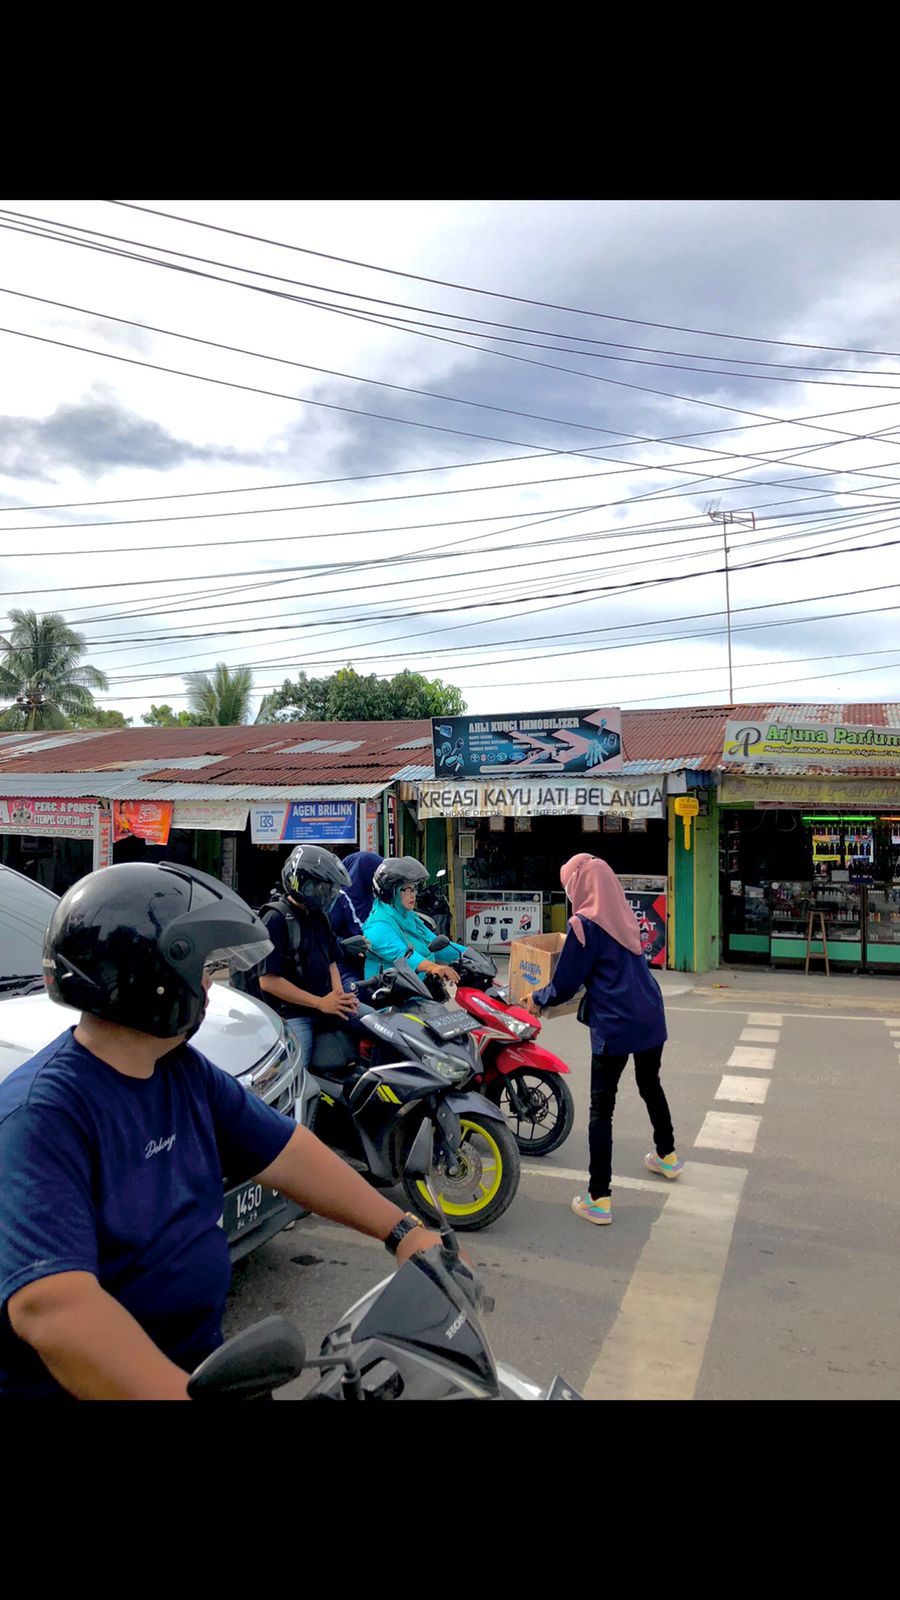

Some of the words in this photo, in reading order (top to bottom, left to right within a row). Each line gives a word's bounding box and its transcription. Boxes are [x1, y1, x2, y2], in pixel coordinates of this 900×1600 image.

[468, 722, 490, 733] AHLI
[491, 720, 518, 732] KUNCI
[519, 717, 580, 731] IMMOBILIZER
[766, 725, 828, 744] Arjuna
[763, 745, 797, 754] Menjual
[851, 749, 887, 757] Original
[419, 788, 478, 808] KREASI
[484, 788, 531, 807] KAYU
[536, 788, 569, 806] JATI
[575, 787, 664, 808] BELANDA
[293, 804, 316, 816] AGEN
[318, 803, 353, 816] BRILINK
[373, 1023, 394, 1039] YAMAHA
[236, 1184, 262, 1218] 1450
